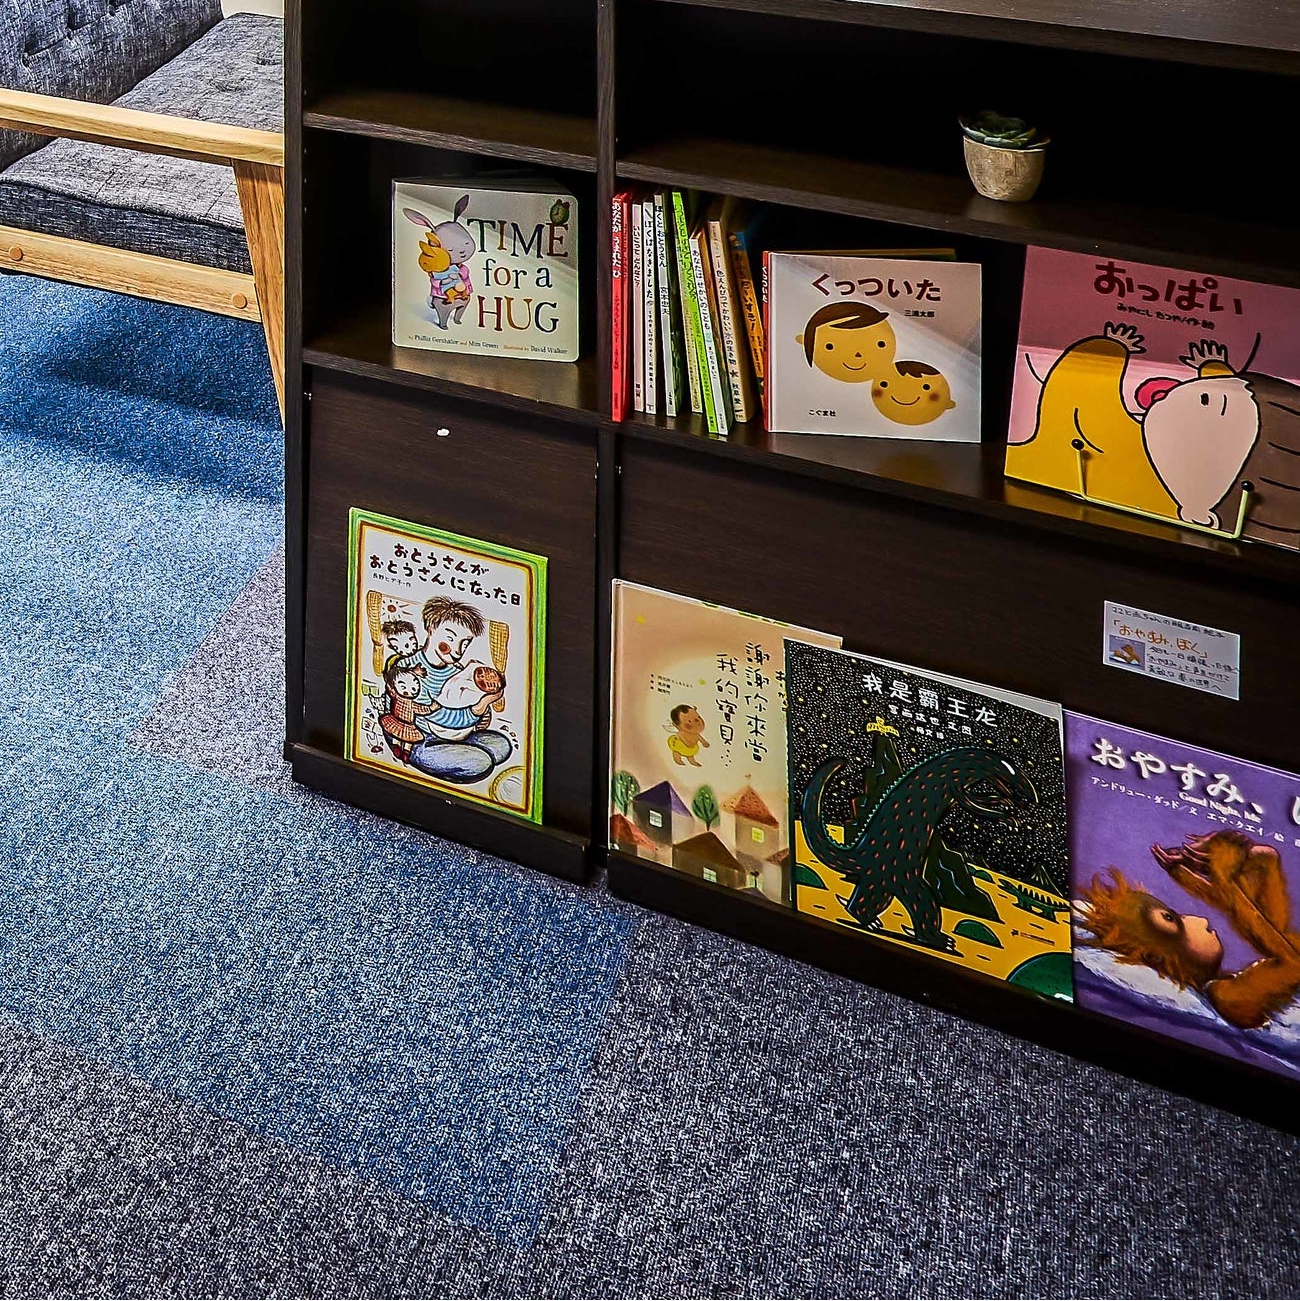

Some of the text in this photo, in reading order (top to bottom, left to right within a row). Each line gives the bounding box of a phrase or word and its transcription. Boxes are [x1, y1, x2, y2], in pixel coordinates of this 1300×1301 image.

[612, 199, 622, 232] あなたが
[467, 218, 570, 259] TIME
[612, 235, 622, 268] うまれた
[655, 205, 667, 268] ぼくと おとうさん
[482, 258, 553, 289] for a
[644, 220, 653, 299] ぼくはなきました
[692, 250, 701, 281] あなたは
[810, 273, 942, 302] くっついた
[1093, 261, 1243, 315] おっぱい
[477, 296, 560, 334] HUG
[903, 308, 935, 319] 三浦太郎
[807, 408, 836, 418] こぐま社
[394, 543, 489, 577] おとうさんが
[862, 671, 998, 728] 我是霸王龙
[1091, 737, 1264, 815] おやすみ、
[1178, 791, 1208, 808] Good
